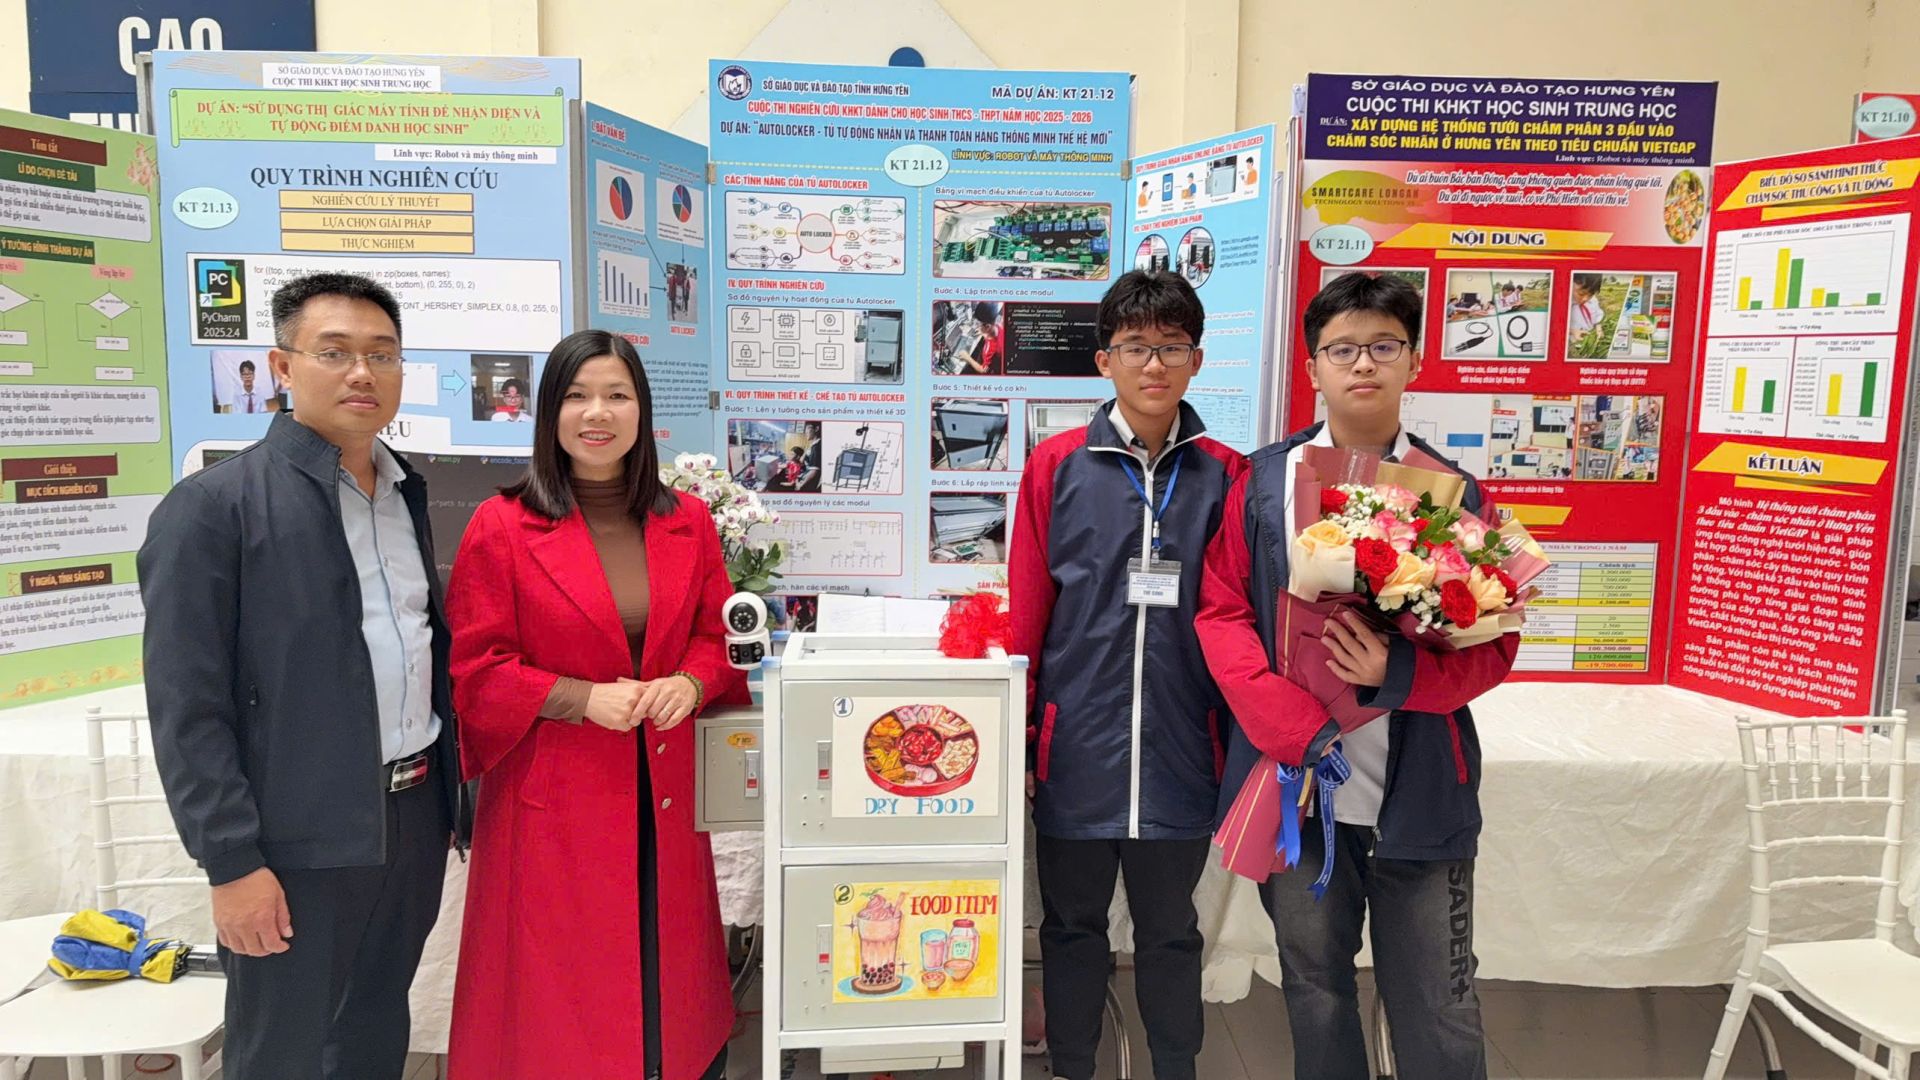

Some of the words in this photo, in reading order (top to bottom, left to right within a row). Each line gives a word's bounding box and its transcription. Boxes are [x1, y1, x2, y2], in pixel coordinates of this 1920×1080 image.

[272, 76, 296, 87] CUỘC
[298, 78, 313, 86] THI
[314, 78, 339, 87] KHKT
[340, 79, 359, 88] HỌC
[360, 79, 380, 87] SINH
[381, 80, 412, 88] TRUNG
[413, 80, 432, 89] HỌC
[763, 78, 774, 90] SỞ
[775, 78, 792, 90] GIÁO
[794, 81, 808, 93] DỤC
[811, 79, 820, 92] VÀ
[822, 80, 836, 92] ĐÀO
[838, 83, 852, 95] TẠO
[854, 81, 871, 94] TỈNH
[872, 84, 893, 95] HƯNG
[895, 83, 909, 95] YÊN
[1352, 79, 1379, 90] SỞ
[1382, 79, 1426, 91] GIÁO
[1431, 83, 1468, 94] DỤC
[1472, 81, 1496, 93] VÀ
[1500, 82, 1539, 94] ĐÀO
[1543, 85, 1580, 96] TẠO
[1584, 86, 1636, 96] HƯNG
[1640, 84, 1675, 96] YÊN
[992, 85, 1012, 98] MÃ
[1016, 88, 1035, 100] DỰ
[1037, 86, 1059, 98] ÁN:
[1062, 89, 1077, 98] KT
[1080, 89, 1114, 99] 21.12
[197, 102, 216, 116] DỰ
[219, 100, 240, 114] ÁN:
[268, 104, 303, 117] DỤNG
[305, 104, 328, 118] THỊ
[334, 102, 366, 116] GIÁC
[368, 102, 396, 117] MÁY
[399, 103, 430, 117] TÍNH
[452, 104, 488, 120] NHẬN
[491, 105, 520, 121] DIỆN
[523, 105, 541, 119] VÀ
[748, 99, 771, 115] CUỘC
[773, 103, 786, 114] THI
[788, 101, 820, 115] NGHIÊN
[822, 102, 839, 116] CỨU
[842, 106, 863, 117] KHKT
[865, 104, 888, 118] DÀNH
[891, 107, 908, 118] CHO
[910, 108, 927, 121] HỌC
[929, 108, 949, 119] SINH
[951, 109, 972, 120] THCS
[980, 109, 1000, 120] THPT
[1002, 107, 1022, 121] NĂM
[1024, 110, 1041, 123] HỌC
[1043, 111, 1064, 122] 2025
[1071, 111, 1092, 122] 2026
[1346, 94, 1397, 116] CUỘC
[1401, 99, 1429, 113] THI
[1434, 100, 1482, 114] KHKT
[1486, 100, 1524, 118] HỌC
[1528, 101, 1569, 116] SINH
[1573, 102, 1634, 117] TRUNG
[1639, 103, 1677, 121] HỌC
[1861, 112, 1878, 122] KT
[1881, 112, 1909, 122] 21.10
[270, 120, 287, 133] TỰ
[291, 118, 327, 134] ĐỘNG
[365, 122, 400, 133] DANH
[403, 122, 431, 136] HỌC
[720, 122, 733, 135] DỰ
[736, 119, 751, 134] ÁN:
[824, 123, 835, 137] TỦ
[838, 127, 849, 140] TỰ
[850, 124, 875, 141] ĐỘNG
[877, 125, 902, 142] NHẬN
[904, 126, 915, 140] VÀ
[918, 130, 947, 141] THANH
[949, 127, 972, 142] TOÁN
[974, 128, 999, 142] HÀNG
[1001, 128, 1030, 143] THÔNG
[1032, 132, 1056, 143] MINH
[1058, 128, 1074, 144] THẾ
[1076, 129, 1088, 146] HỆ
[1351, 116, 1377, 131] XÂY
[1381, 120, 1418, 134] DỰNG
[1421, 117, 1438, 135] HỆ
[1442, 116, 1486, 133] THỐNG
[1489, 118, 1519, 134] TƯỚI
[1565, 119, 1602, 135] PHÂN
[1605, 123, 1614, 136] 3
[1648, 121, 1674, 137] VÀO
[1370, 133, 1397, 148] SÓC
[1442, 134, 1451, 149] Ở
[1454, 138, 1491, 150] HƯNG
[1496, 135, 1521, 150] YÊN
[1524, 139, 1557, 151] THEO
[1561, 137, 1589, 152] TIÊU
[1642, 141, 1696, 154] VIETGAP
[393, 149, 412, 158] Lĩnh
[414, 149, 432, 160] vực:
[434, 150, 459, 159] Robot
[461, 150, 471, 159] và
[473, 151, 490, 161] máy
[492, 151, 515, 162] thông
[517, 152, 538, 160] minh
[890, 160, 909, 170] KT
[912, 160, 943, 170] 21.12
[250, 168, 294, 188] QUY
[299, 164, 362, 187] TRÌNH
[369, 165, 448, 188] NGHIÊN
[454, 166, 499, 188] CỨU
[312, 193, 354, 206] NGHIÊN
[355, 194, 378, 207] CỨU
[381, 194, 394, 207] LÝ
[397, 194, 440, 208] THUYẾT
[1312, 187, 1374, 198] SMARTCARE
[179, 202, 199, 213] KT
[202, 202, 233, 213] 21.13
[1316, 238, 1334, 250] KT
[1337, 239, 1366, 250] 21.11
[1452, 230, 1484, 247] NỘI
[1491, 233, 1545, 245] DUNG
[209, 273, 228, 285] PC
[202, 312, 241, 323] PyCharm
[204, 327, 240, 337] 2025.2.4
[1748, 453, 1776, 470] KẾT
[1779, 456, 1821, 475] LUẬN
[865, 798, 899, 814] DRY
[915, 797, 974, 814] FOOD
[911, 896, 952, 916] FOOD
